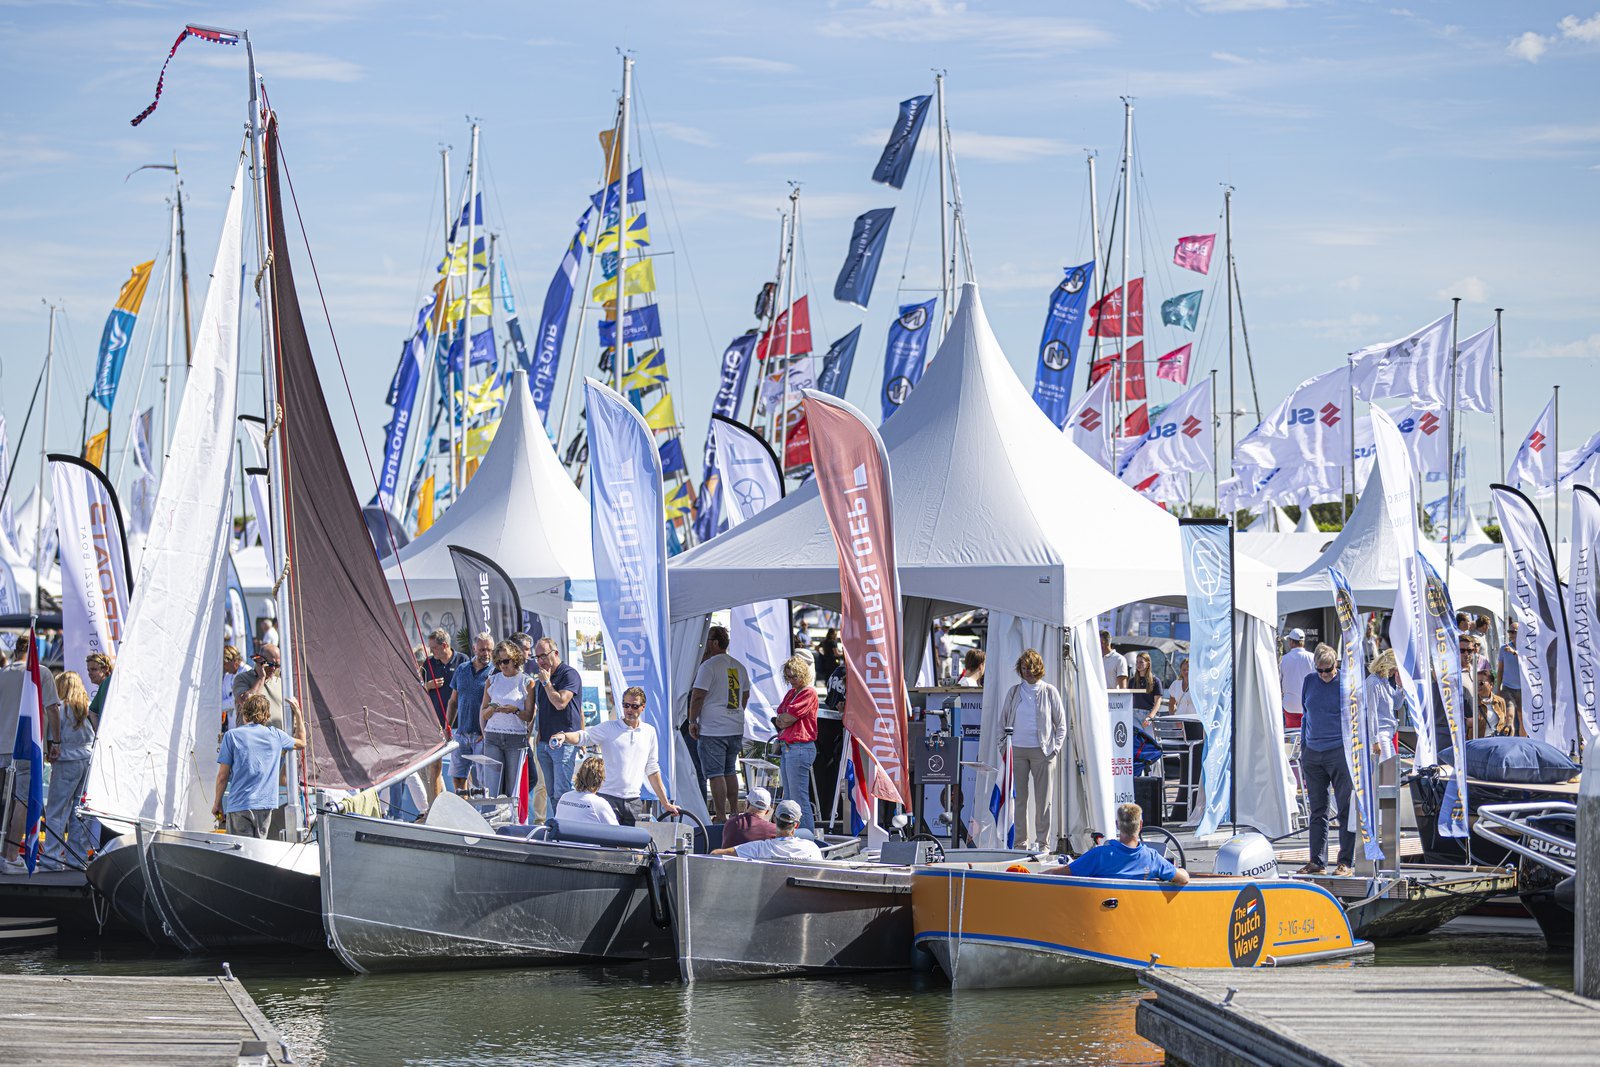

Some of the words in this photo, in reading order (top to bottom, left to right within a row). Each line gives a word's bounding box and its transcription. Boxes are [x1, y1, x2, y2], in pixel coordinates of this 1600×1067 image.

[857, 218, 873, 254] BAVARIA
[1111, 766, 1133, 776] BOATS
[1529, 838, 1576, 858] SUZU
[1241, 858, 1278, 877] HONDA
[1234, 906, 1246, 921] The
[1234, 913, 1261, 941] Dutch
[1234, 935, 1259, 959] Wave
